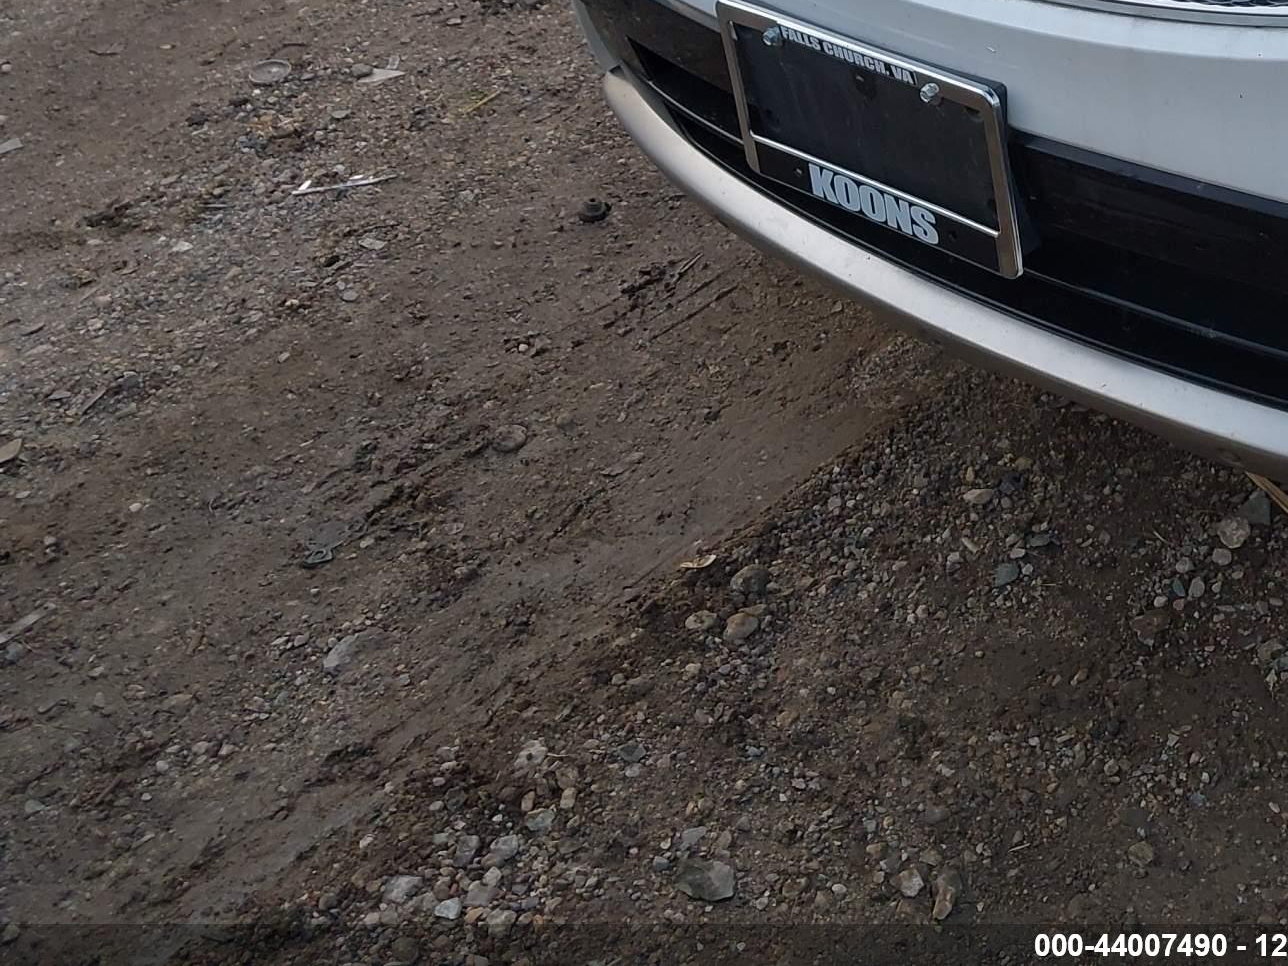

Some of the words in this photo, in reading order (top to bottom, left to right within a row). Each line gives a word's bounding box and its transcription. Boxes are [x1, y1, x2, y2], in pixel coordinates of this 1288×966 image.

[780, 25, 821, 50] FALLS
[890, 65, 914, 85] VA
[808, 162, 939, 245] KOONS
